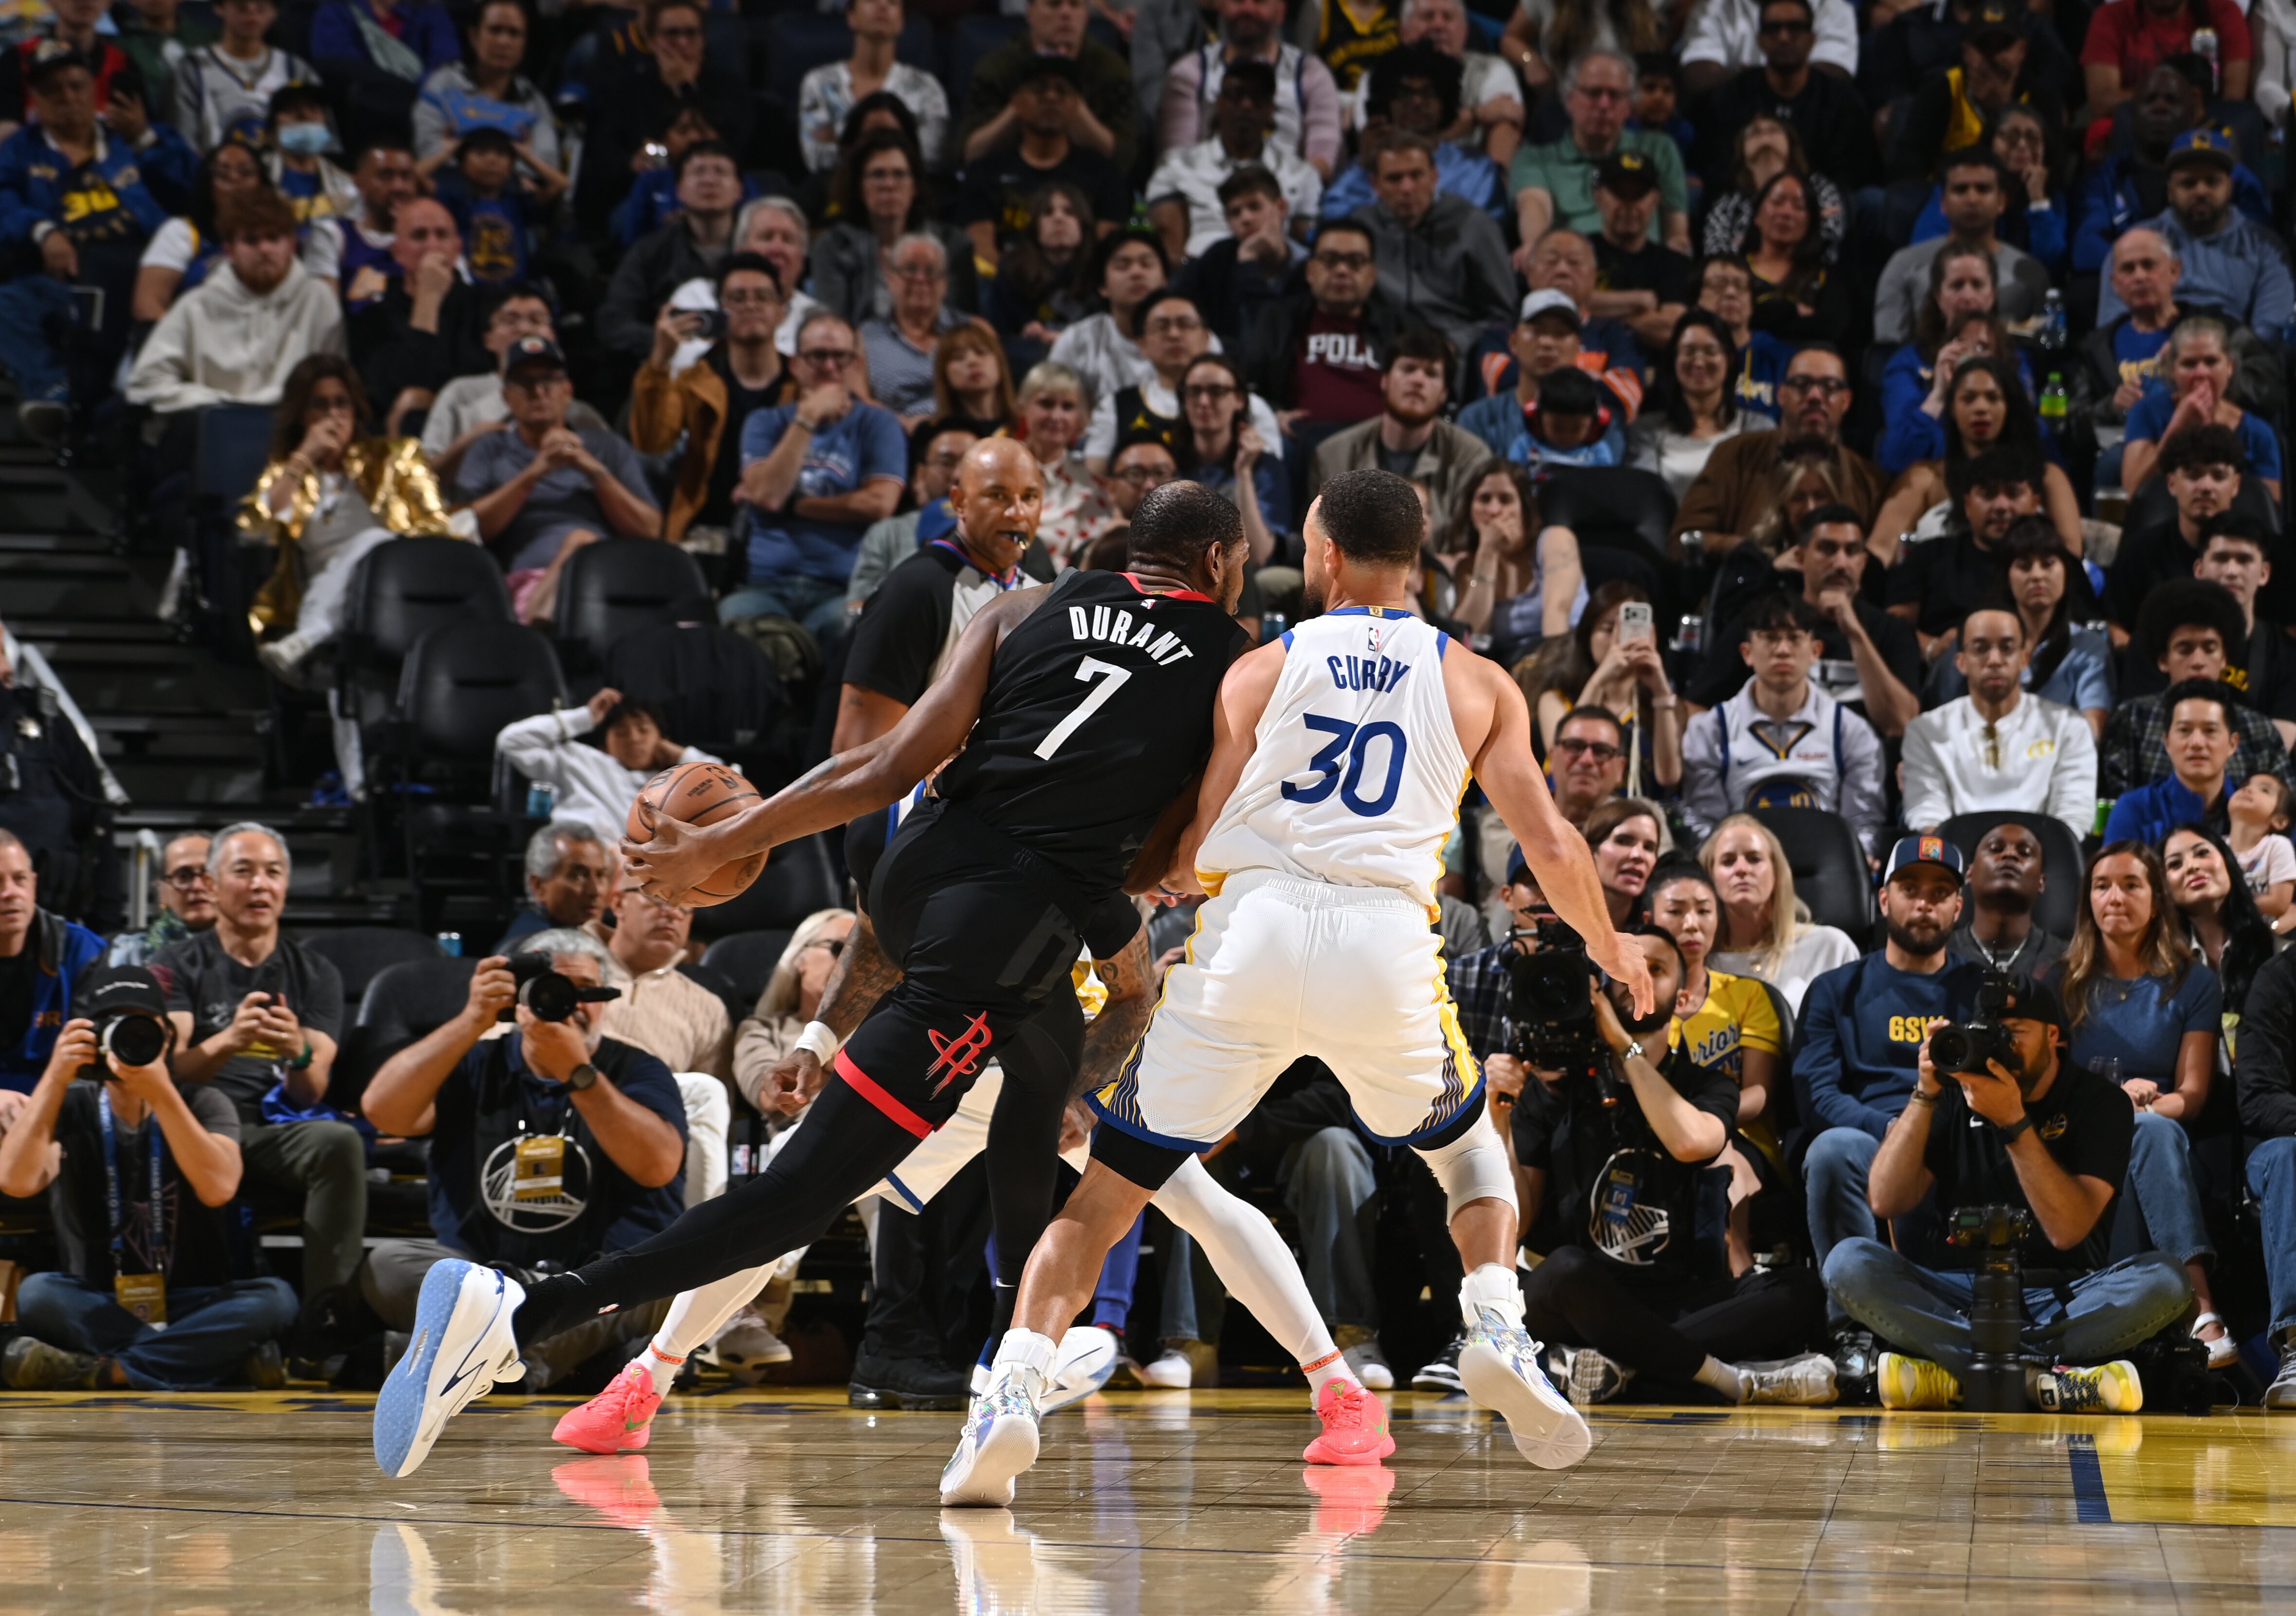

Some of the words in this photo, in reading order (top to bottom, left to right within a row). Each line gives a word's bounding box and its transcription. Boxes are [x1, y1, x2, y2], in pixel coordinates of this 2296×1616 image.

[1068, 605, 1194, 666] DURANT
[1326, 655, 1410, 694] CURRY
[1034, 655, 1132, 761] 7
[1281, 713, 1407, 817] 30
